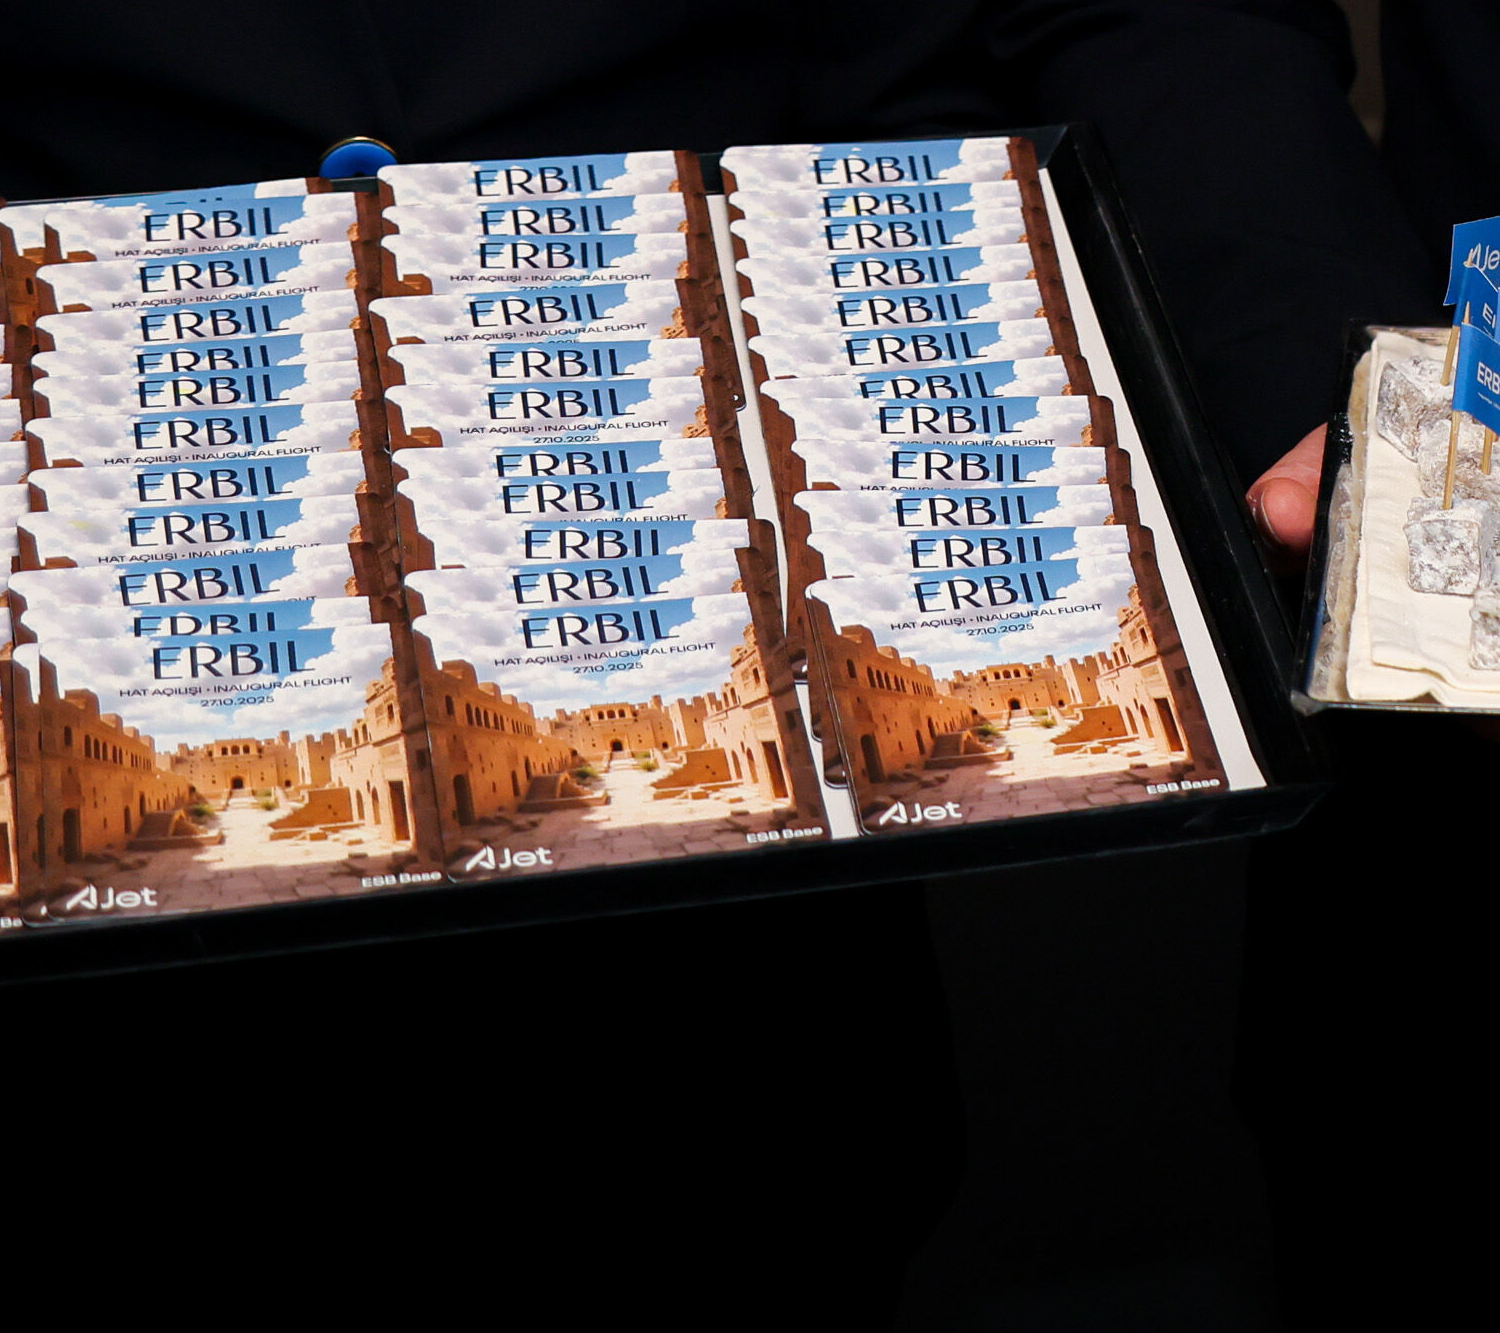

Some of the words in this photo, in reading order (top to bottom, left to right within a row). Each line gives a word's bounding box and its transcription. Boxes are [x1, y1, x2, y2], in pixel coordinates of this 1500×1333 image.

[474, 164, 613, 197] ERBIL
[813, 154, 949, 185] ERBIL
[144, 207, 289, 242] ERBIL
[480, 205, 621, 236] ERBIL
[824, 219, 963, 251] ERBIL
[115, 249, 143, 257] HAT
[198, 241, 274, 253] INAUGURAL
[277, 238, 322, 248] FLIGHT
[479, 242, 620, 269] ERBIL
[139, 256, 287, 294] ERBIL
[531, 274, 607, 282] INAUGURAL
[609, 273, 652, 281] FLIGHT
[830, 255, 970, 288] ERBIL
[111, 300, 138, 309] HAT
[196, 290, 274, 303] INAUGURAL
[276, 285, 320, 296] FLIGHT
[468, 293, 614, 328] ERBIL
[837, 293, 979, 327] ERBIL
[140, 305, 289, 342] ERBIL
[444, 335, 471, 343] HAT
[526, 326, 603, 338] INAUGURAL
[605, 322, 648, 332] FLIGHT
[136, 345, 270, 374] ERBIL
[488, 348, 634, 379] ERBIL
[845, 331, 988, 367] ERBIL
[138, 374, 290, 408] ERBIL
[487, 388, 636, 420] ERBIL
[133, 415, 288, 450] ERBIL
[544, 422, 622, 432] INAUGURAL
[625, 420, 669, 429] FLIGHT
[878, 405, 1023, 434] ERBIL
[103, 457, 132, 465] HAT
[192, 449, 273, 461] INAUGURAL
[276, 445, 322, 456] FLIGHT
[891, 450, 1036, 483] ERBIL
[137, 466, 293, 502] ERBIL
[502, 480, 654, 514] ERBIL
[895, 495, 1044, 527] ERBIL
[127, 509, 286, 547] ERBIL
[524, 529, 660, 559] ERBIL
[98, 555, 126, 564] HAT
[910, 536, 1043, 569] ERBIL
[118, 563, 281, 607] ERBIL
[512, 565, 669, 604] ERBIL
[914, 571, 1067, 614] ERBIL
[521, 609, 680, 649] ERBIL
[890, 621, 918, 631] HAT
[976, 609, 1057, 623] INAUGURAL
[1058, 603, 1103, 614] FLIGHT
[152, 640, 316, 680] ERBIL
[494, 658, 522, 667] HAT
[583, 647, 667, 661] INAUGURAL
[670, 642, 717, 653] FLIGHT
[119, 689, 149, 697] HAT
[213, 681, 300, 693] INAUGURAL
[303, 676, 352, 687] FLIGHT
[878, 801, 963, 825] AJet
[465, 845, 553, 871] AJet
[66, 884, 158, 910] AJet
